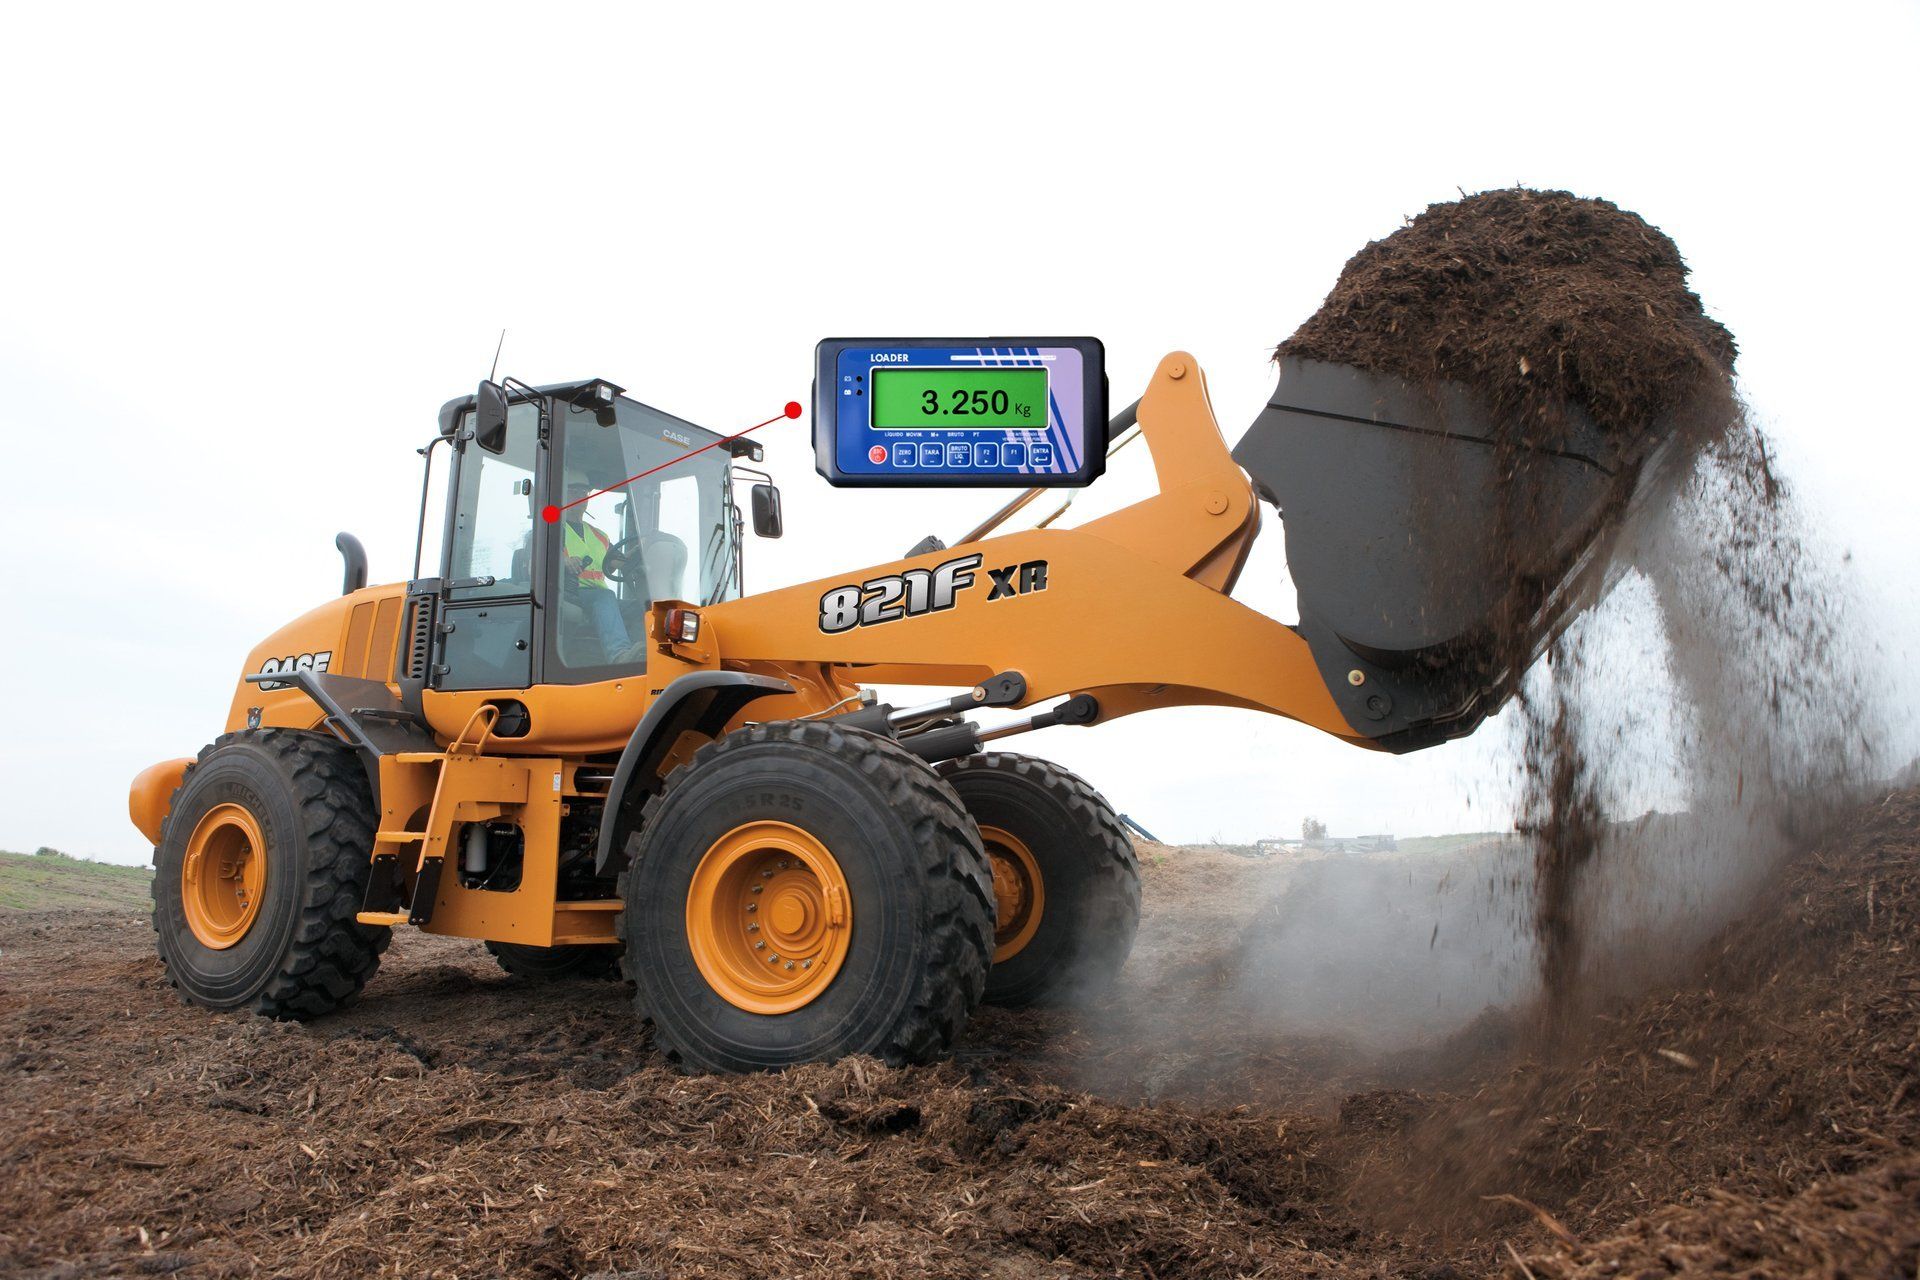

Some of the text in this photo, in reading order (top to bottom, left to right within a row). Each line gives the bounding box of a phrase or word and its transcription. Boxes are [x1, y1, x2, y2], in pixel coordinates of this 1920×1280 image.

[870, 353, 909, 363] LOADER
[921, 389, 1031, 418] 3.250 Kg
[663, 429, 690, 445] CASE
[819, 553, 1048, 634] 821F XR
[259, 651, 332, 690] CASE
